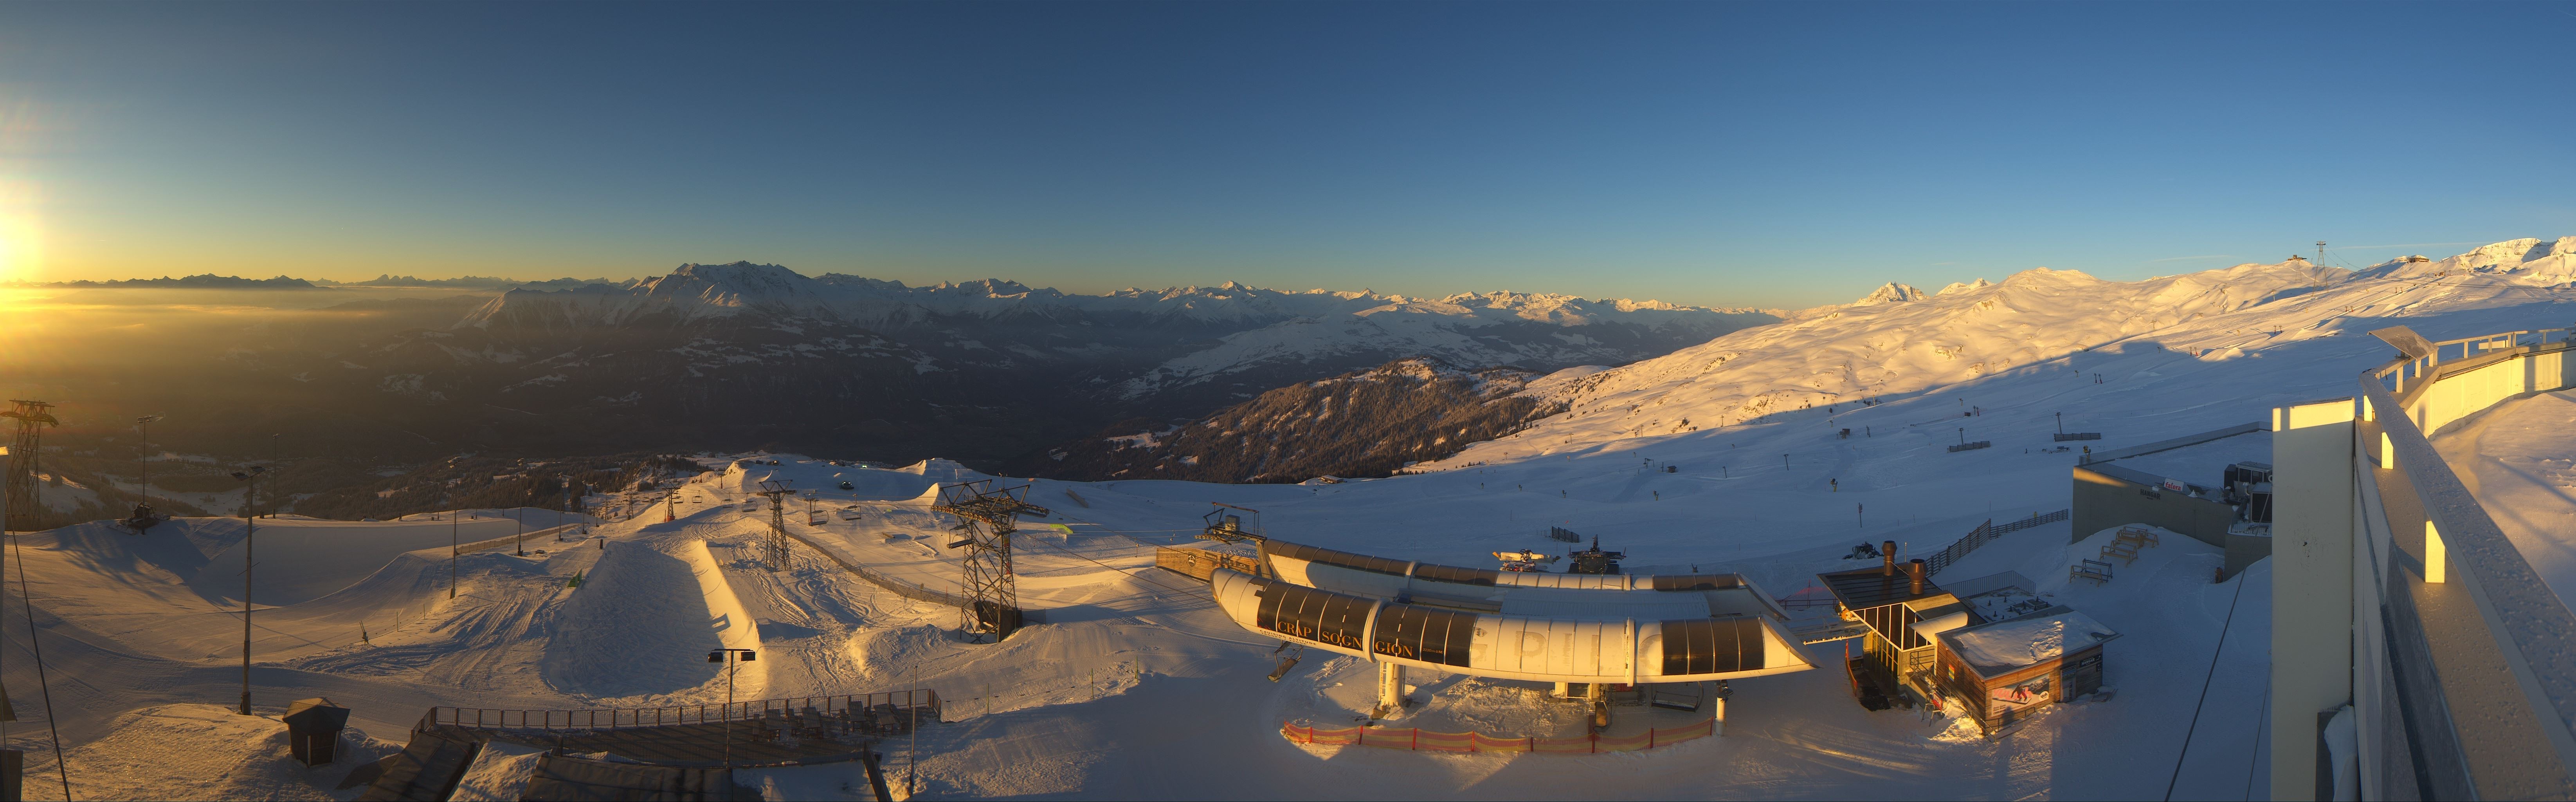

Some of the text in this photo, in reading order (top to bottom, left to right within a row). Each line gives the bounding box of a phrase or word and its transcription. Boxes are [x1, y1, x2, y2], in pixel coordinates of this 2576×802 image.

[2165, 482, 2181, 491] falera
[2140, 489, 2160, 500] HANGAR
[1260, 630, 1317, 645] CRUISING ALTITUDE
[1278, 621, 1413, 657] CRAP SOGN GION
